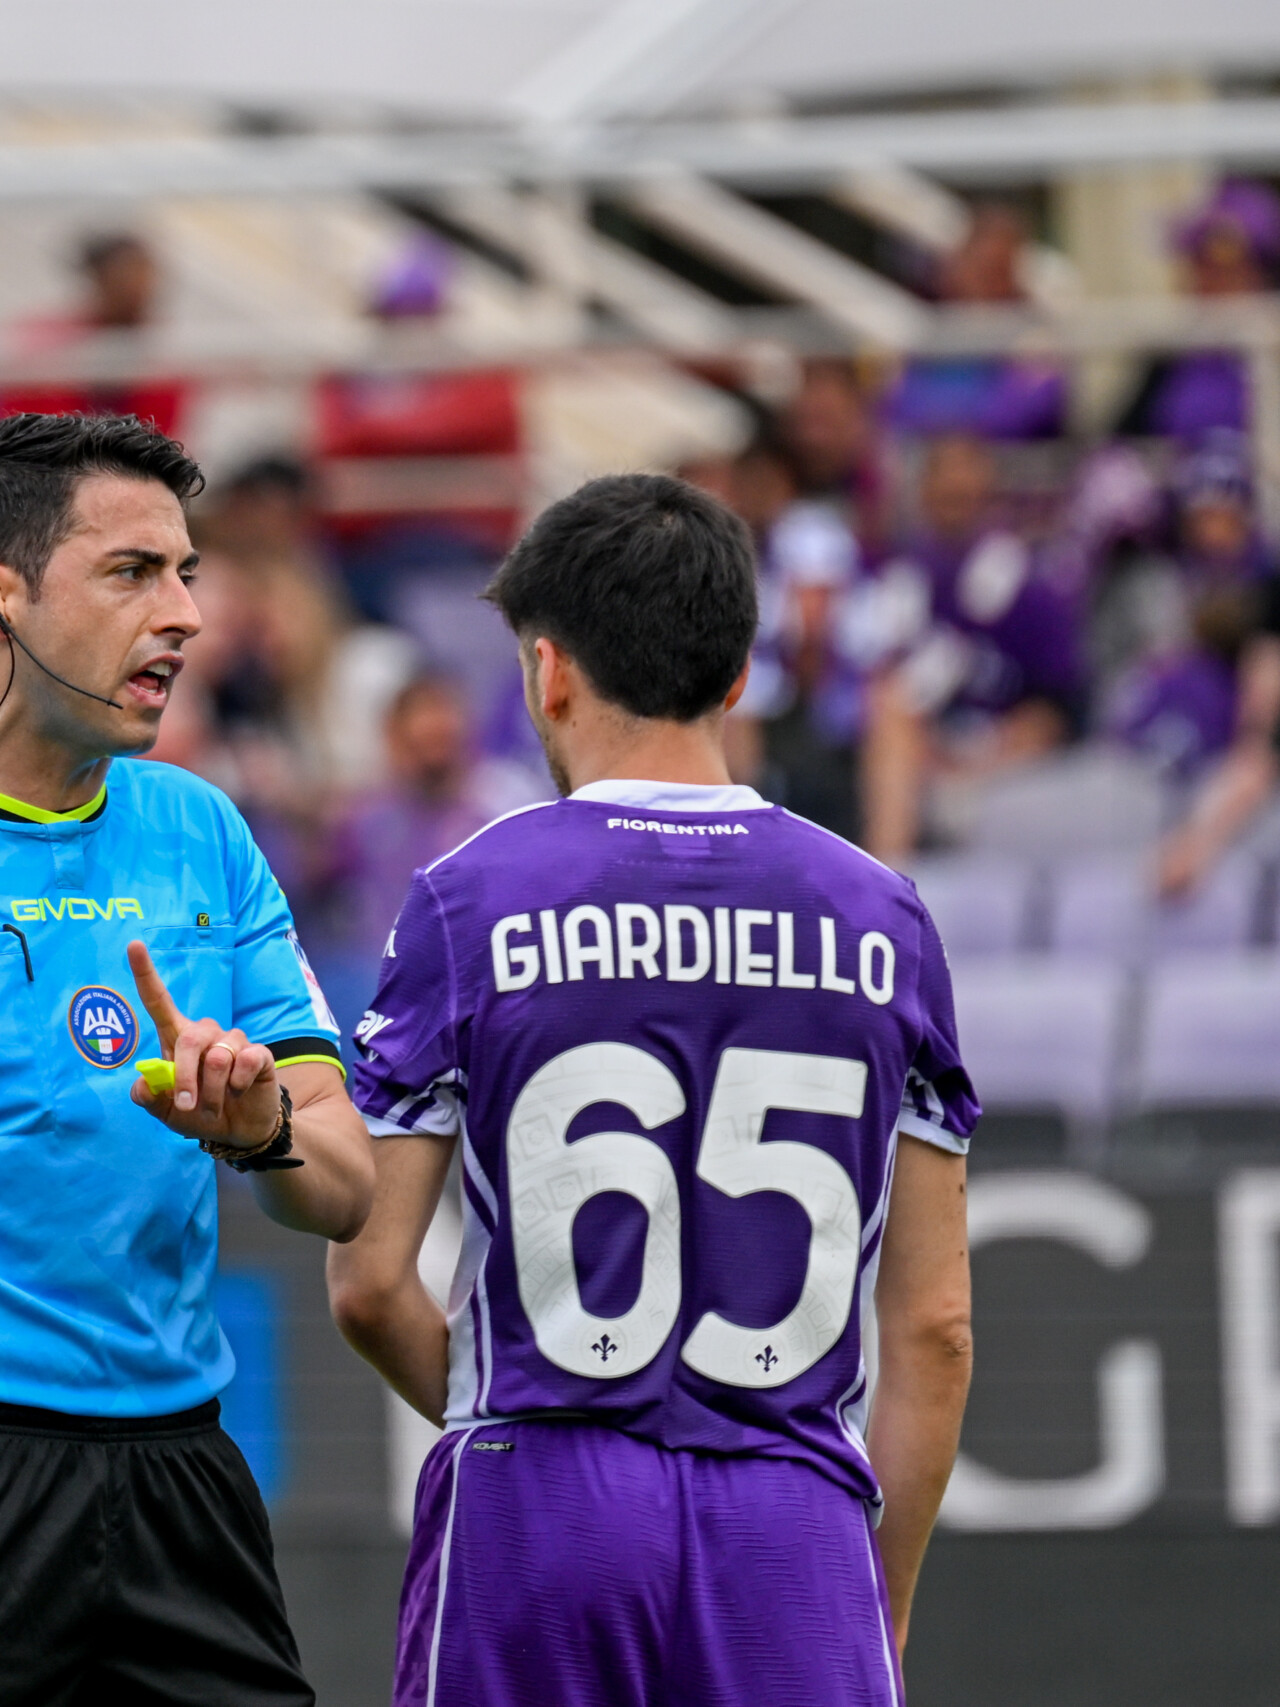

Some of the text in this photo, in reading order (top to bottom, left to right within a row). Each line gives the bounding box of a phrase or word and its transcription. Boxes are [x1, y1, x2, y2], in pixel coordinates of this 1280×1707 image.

[607, 817, 750, 836] FIORENTINA
[11, 897, 144, 921] GIVOVA
[490, 902, 896, 1006] GIARDIELLO
[83, 1007, 126, 1036] AIA
[506, 1041, 868, 1389] 65
